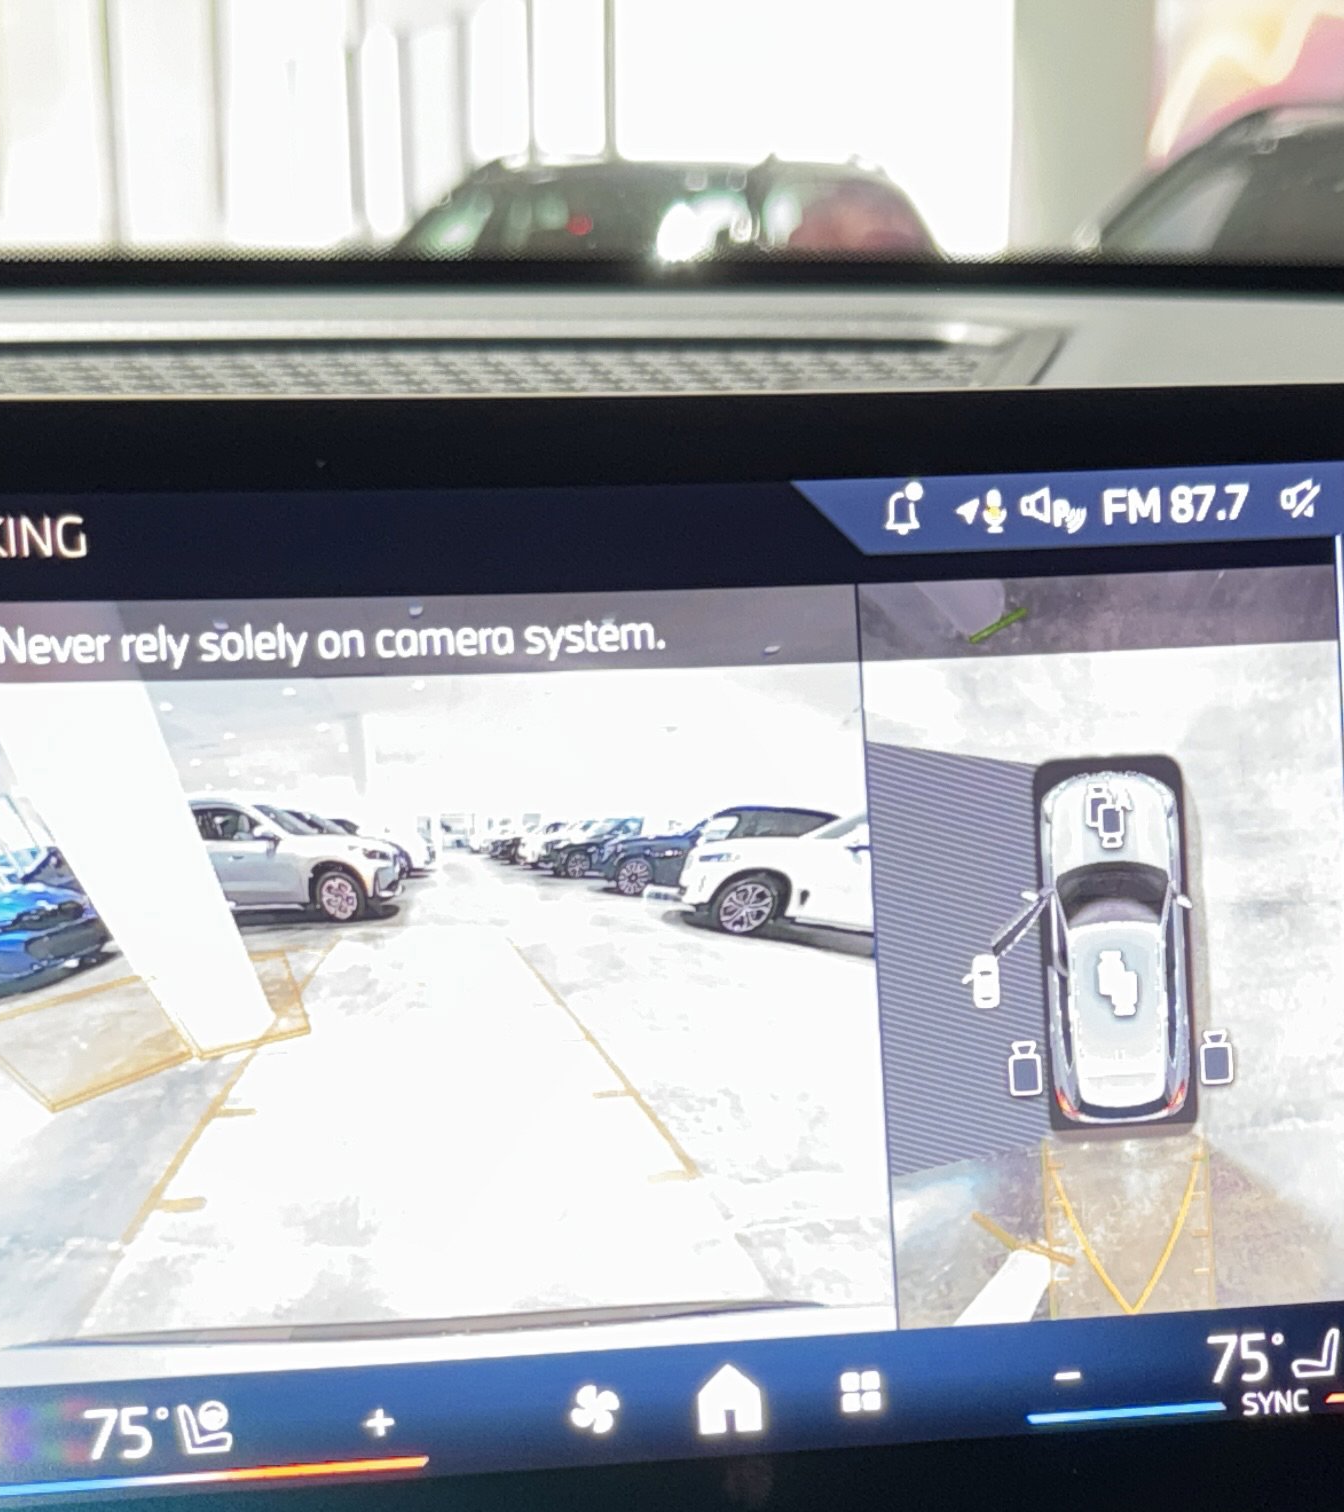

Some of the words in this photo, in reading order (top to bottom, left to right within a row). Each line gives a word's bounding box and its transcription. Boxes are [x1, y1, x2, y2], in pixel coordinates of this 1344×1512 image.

[1103, 487, 1163, 526] FM
[1168, 483, 1251, 523] 87.7
[120, 624, 191, 671] rely
[199, 621, 308, 667] solely
[317, 626, 366, 660] on
[374, 624, 515, 657] camera
[524, 618, 667, 660] system.
[1241, 1388, 1309, 1417] SYNC
